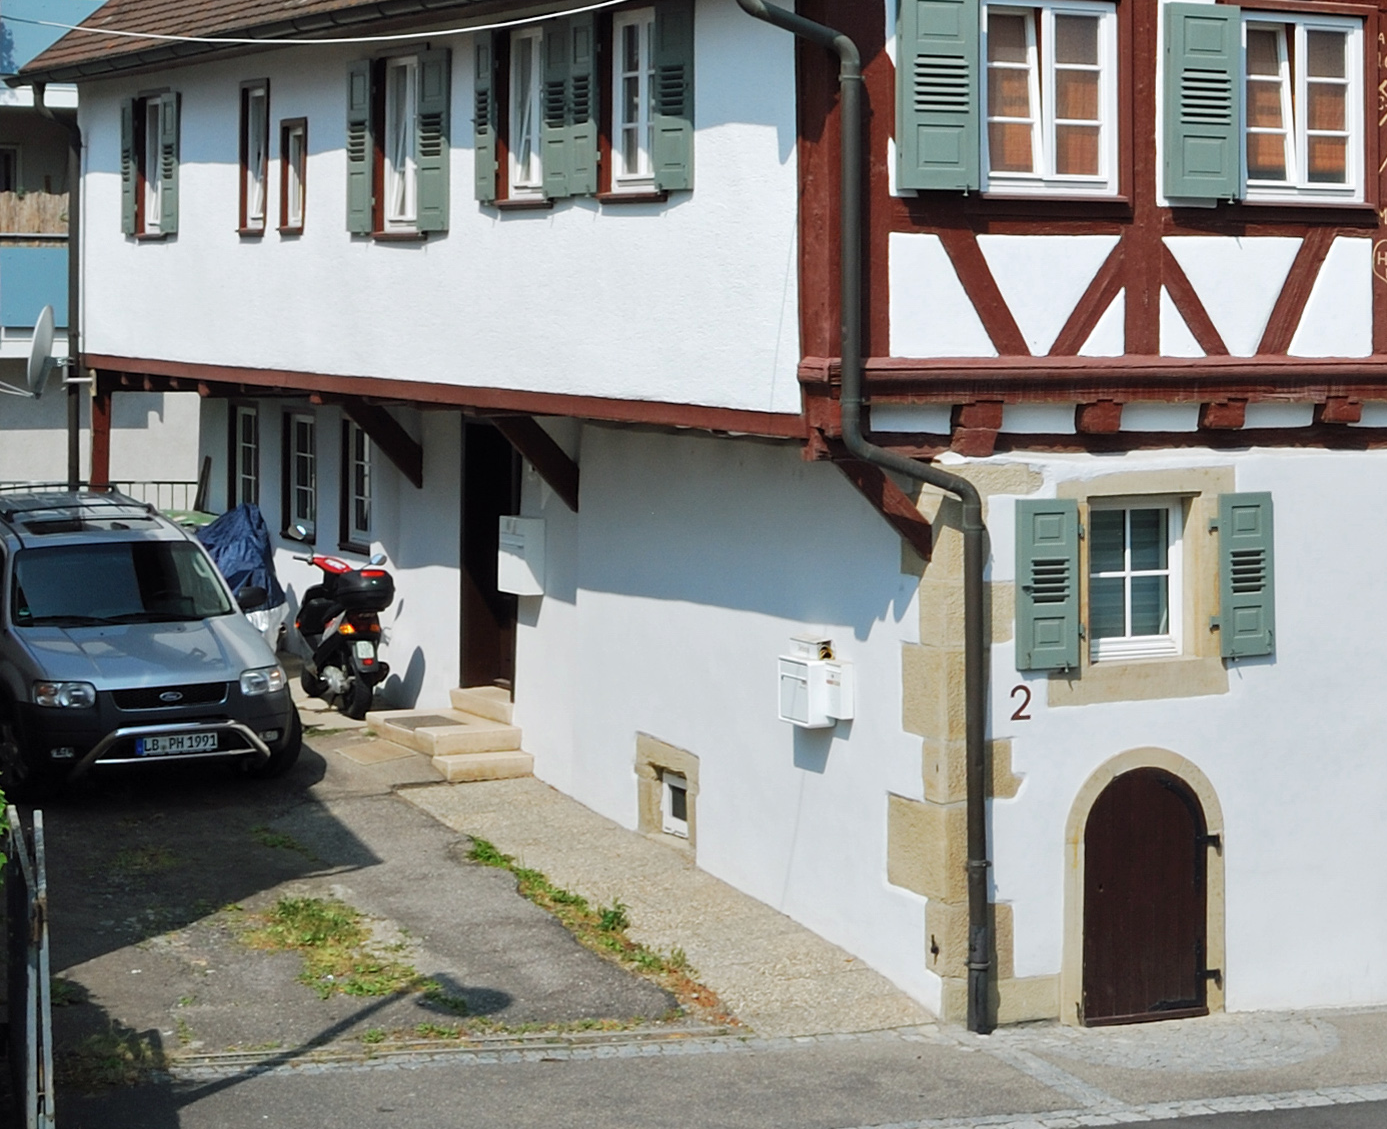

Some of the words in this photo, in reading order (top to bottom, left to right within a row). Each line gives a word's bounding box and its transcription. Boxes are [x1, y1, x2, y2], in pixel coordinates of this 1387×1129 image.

[1010, 684, 1031, 721] 2
[144, 738, 160, 752] LB
[186, 734, 217, 749] 1991
